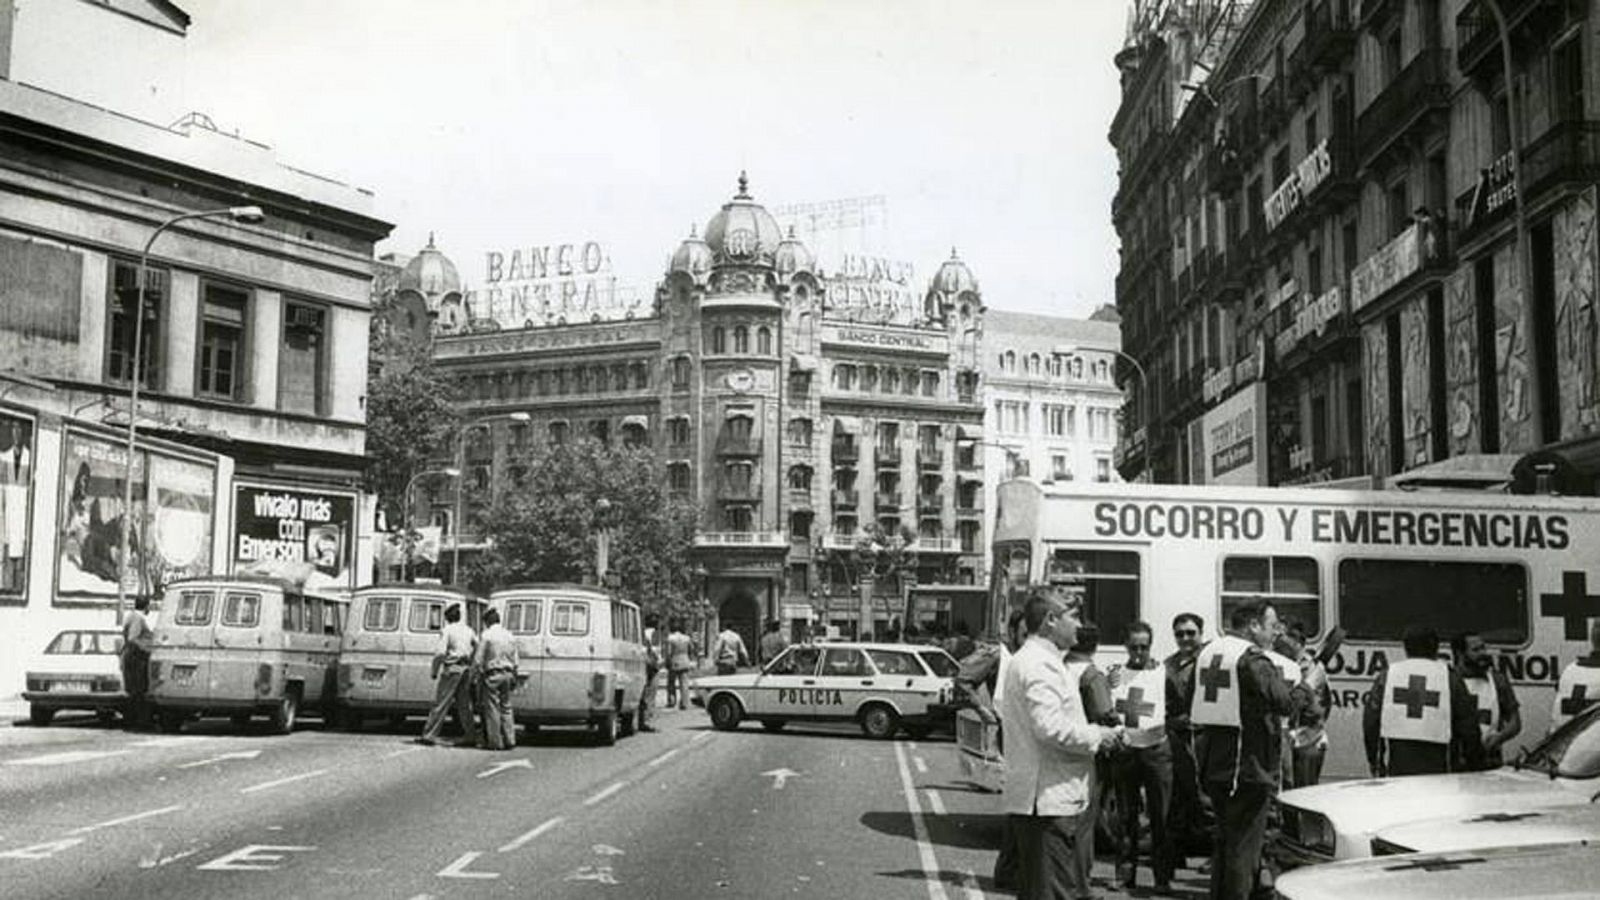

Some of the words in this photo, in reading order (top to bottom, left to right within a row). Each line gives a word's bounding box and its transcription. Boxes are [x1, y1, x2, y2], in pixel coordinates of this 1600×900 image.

[486, 240, 601, 283] BANCO
[838, 329, 876, 345] BANCO
[879, 333, 930, 349] CENTRAL
[300, 497, 332, 522] más
[278, 519, 305, 541] con
[1094, 502, 1265, 541] SOCORRO
[1277, 507, 1301, 542] Y
[1312, 509, 1570, 550] EMERGENCIAS
[239, 534, 305, 563] Emerson
[1324, 650, 1389, 676] OJA
[779, 689, 842, 706] POLICIA
